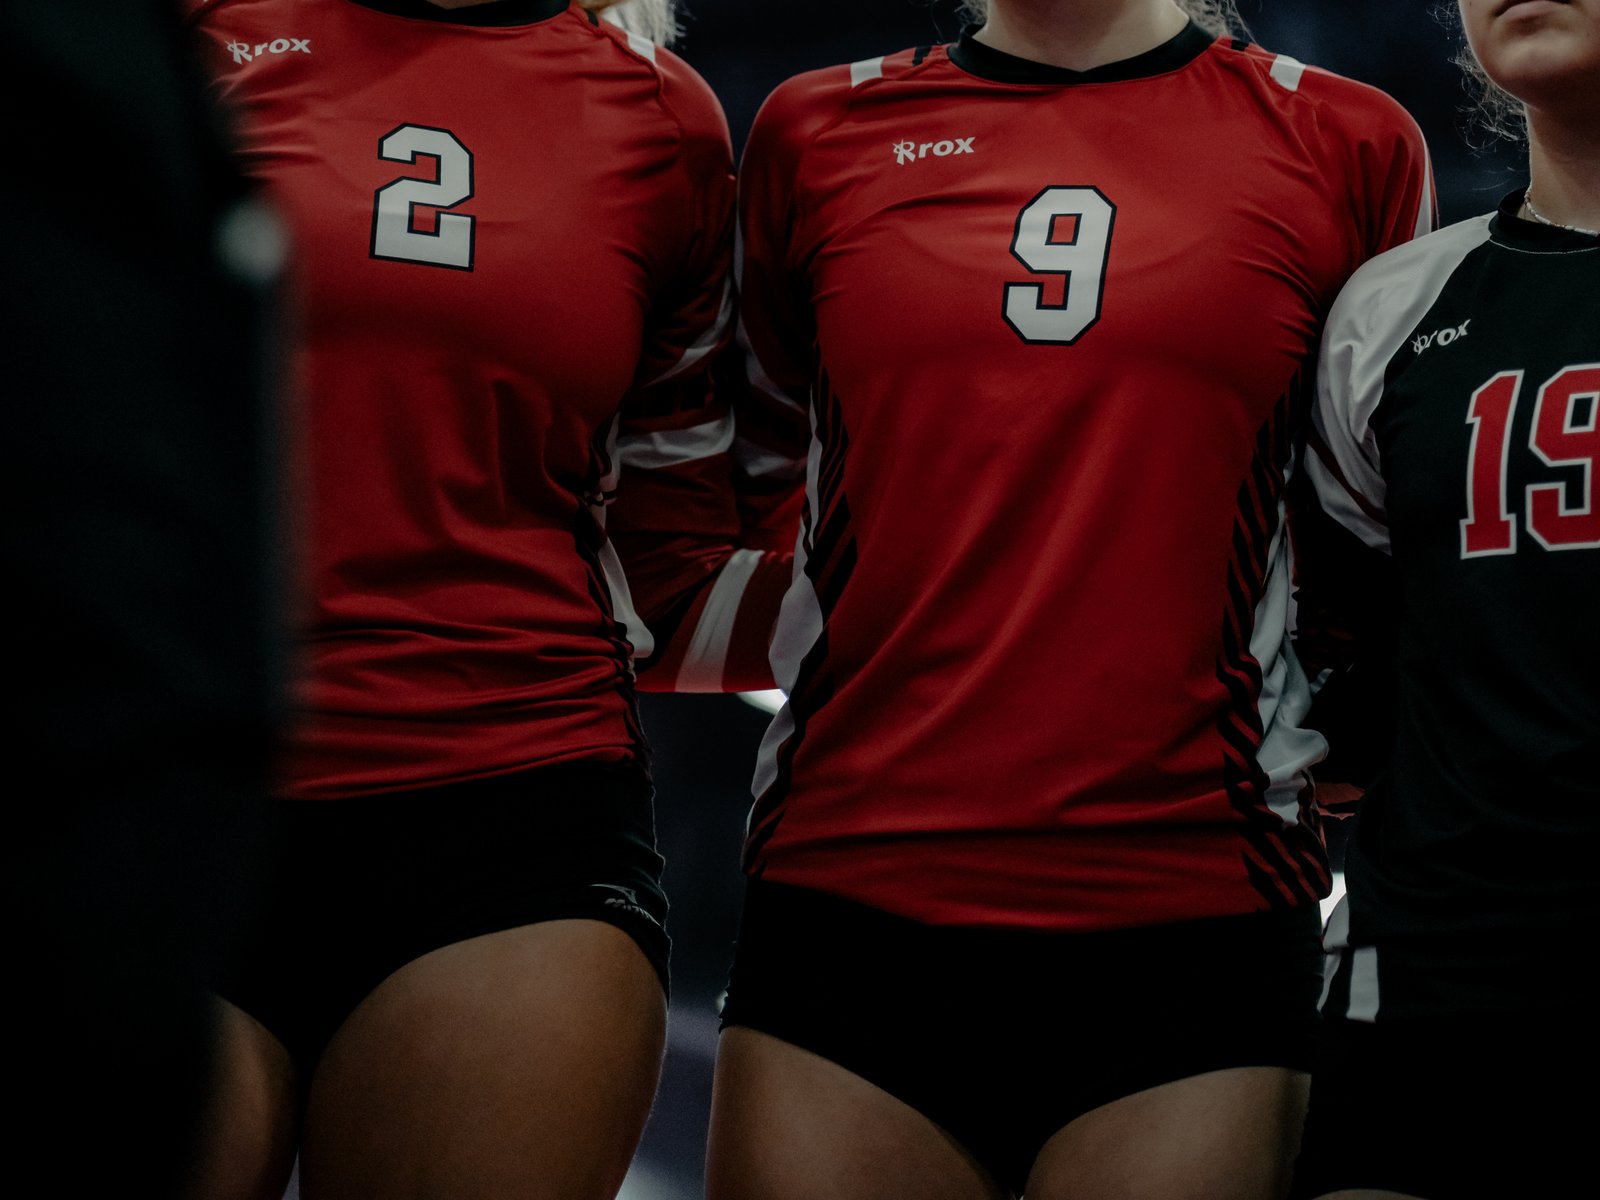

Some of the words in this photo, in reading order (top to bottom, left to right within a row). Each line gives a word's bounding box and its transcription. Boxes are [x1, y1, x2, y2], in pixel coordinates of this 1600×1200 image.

[370, 123, 475, 271] 2
[1001, 185, 1117, 345] 9
[1459, 362, 1600, 560] 19
